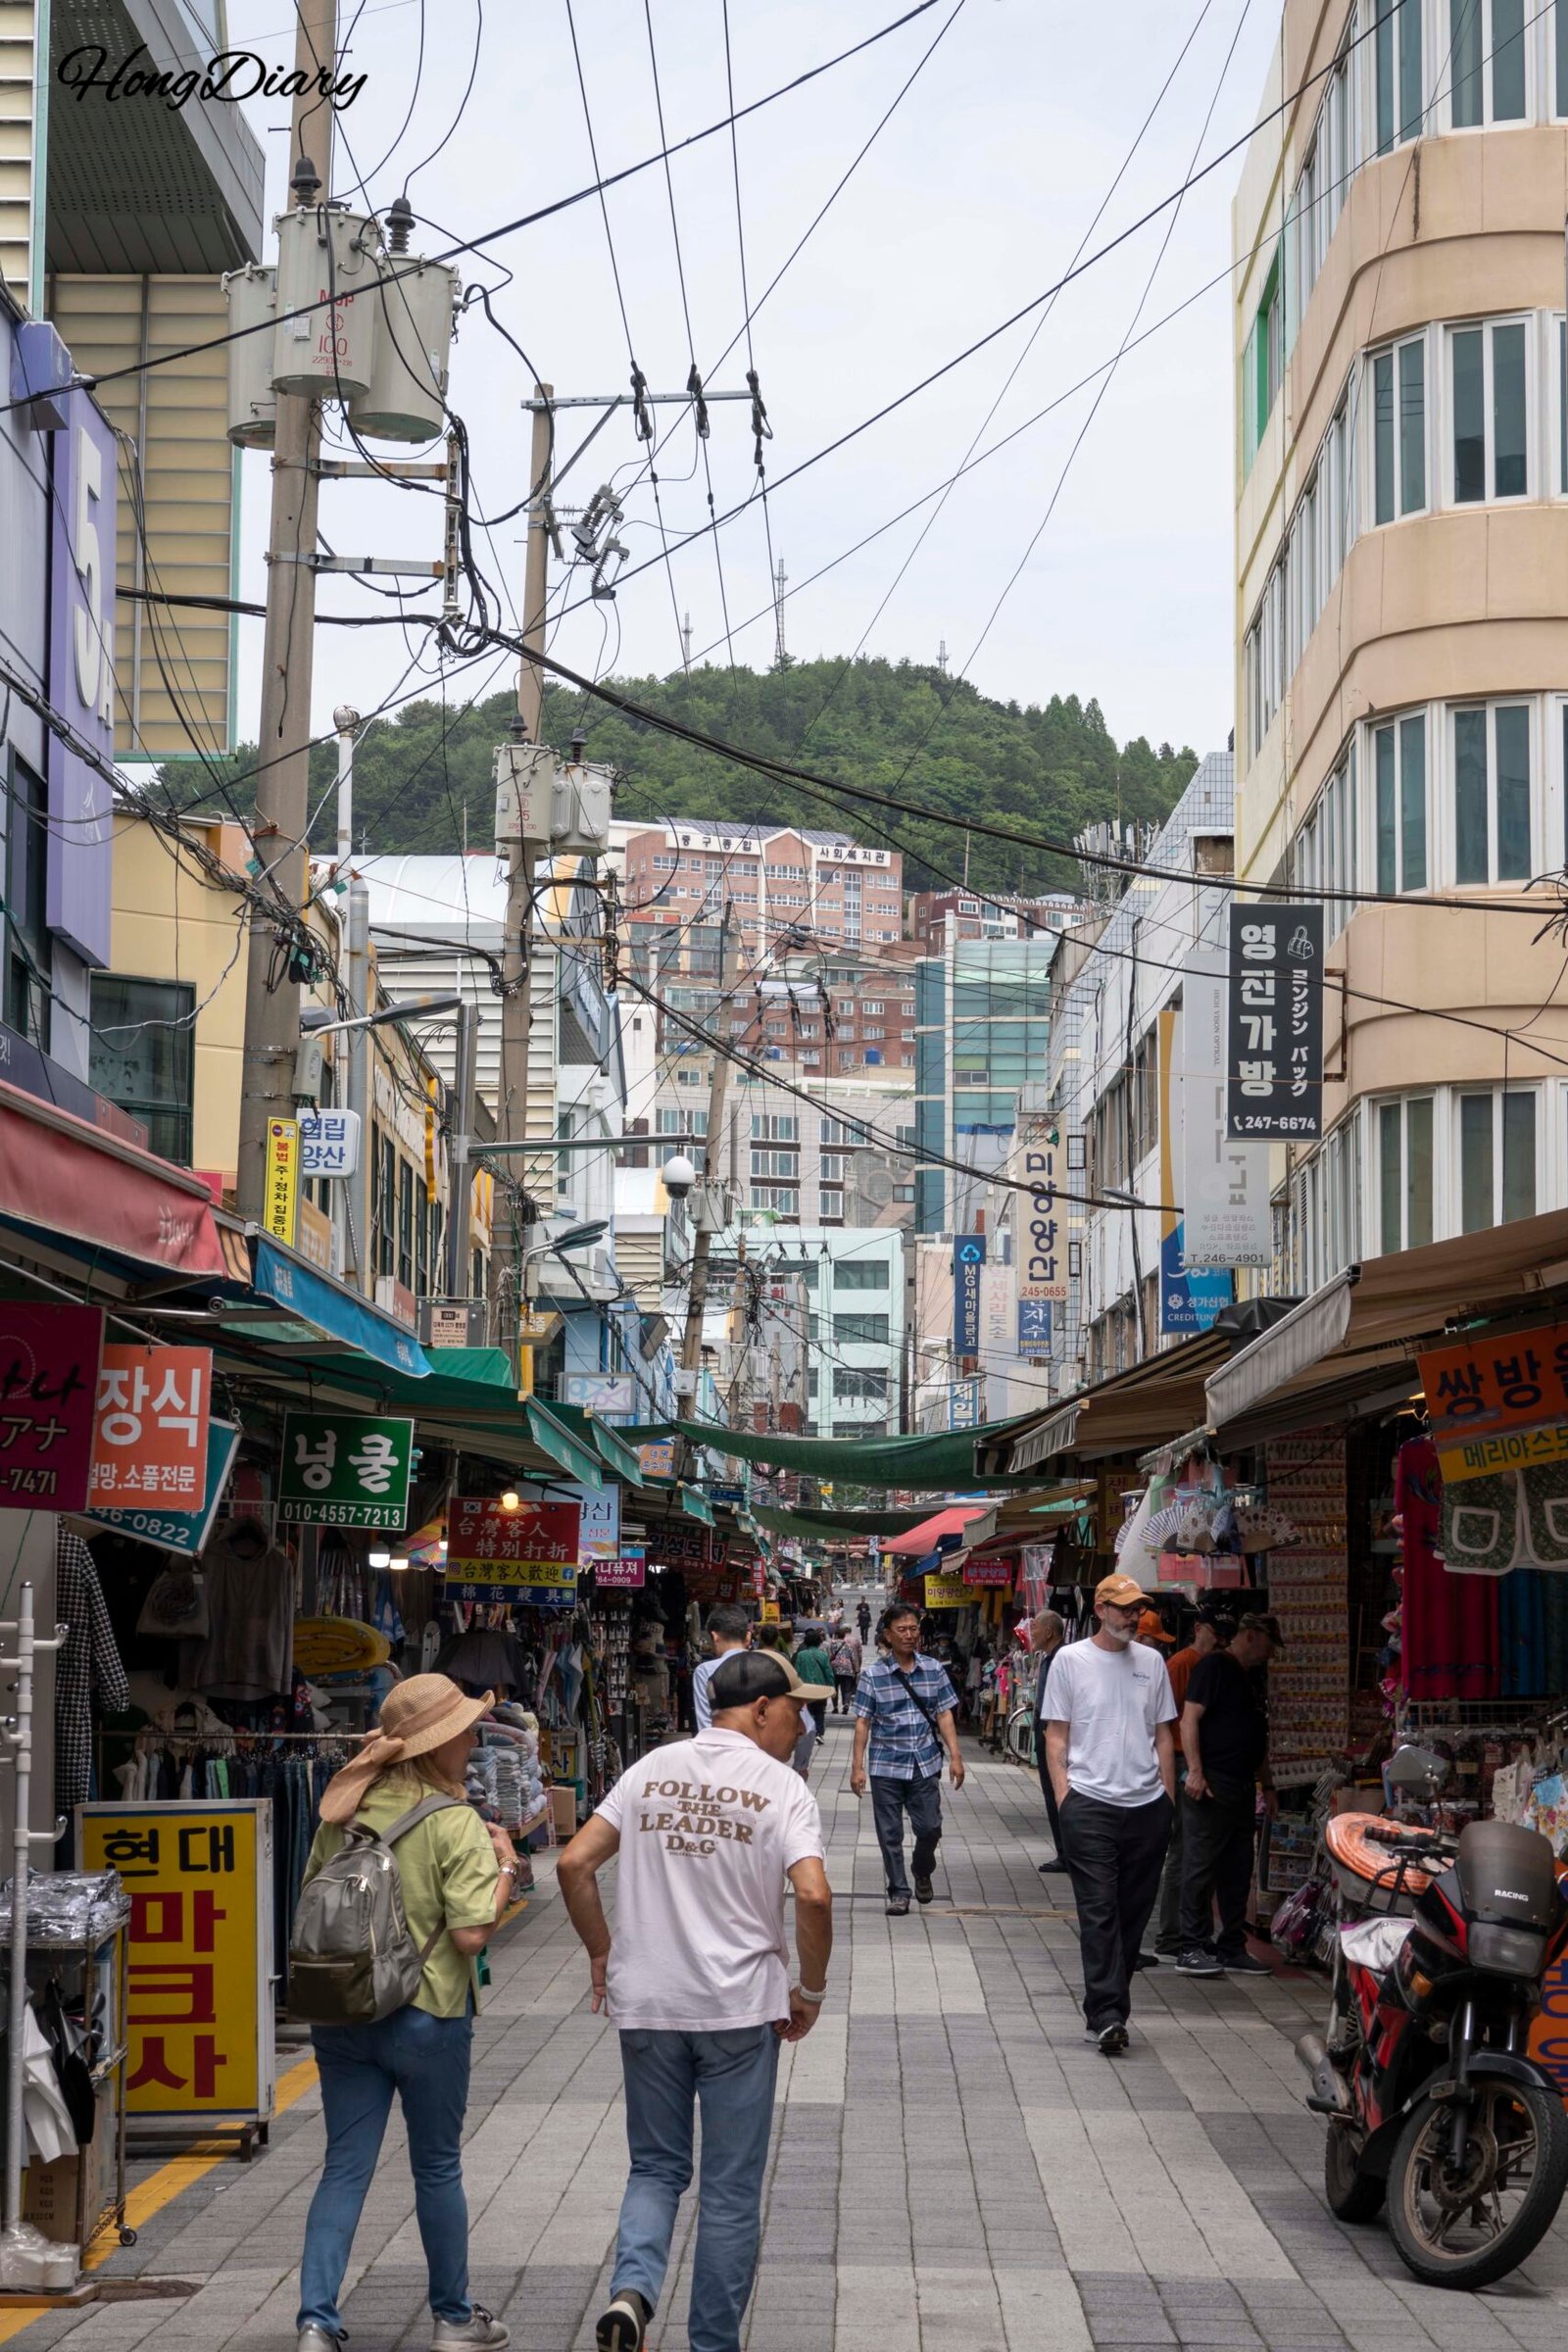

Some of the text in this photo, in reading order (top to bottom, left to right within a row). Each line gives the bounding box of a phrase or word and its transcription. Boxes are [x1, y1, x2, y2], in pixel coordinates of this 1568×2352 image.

[682, 834, 886, 863] 중구종합 사회복지관
[1239, 924, 1277, 1097] 영진가방
[301, 1117, 346, 1141] 협립
[1245, 1115, 1317, 1131] 247-6674
[275, 1142, 290, 1162] 불법
[303, 1146, 346, 1169] 양산
[271, 1204, 287, 1243] 집중단
[1026, 1152, 1058, 1281] 미양양산
[1190, 1253, 1264, 1263] T.246-4901
[1022, 1287, 1067, 1298] 245-0655
[1167, 1313, 1216, 1322] CREDITUN
[294, 1429, 400, 1494] 넝쿨
[87, 1506, 191, 1545] 46-0822
[284, 1501, 401, 1528] 010-4557-7213
[458, 1516, 551, 1539] 台灣客人
[474, 1539, 570, 1561] 特別打折
[464, 1561, 561, 1583] 台灣客人歡迎
[641, 1779, 771, 1813] FOLLOW
[676, 1799, 722, 1817] THE
[639, 1812, 754, 1844] LEADER
[102, 1824, 236, 1877] 현대
[664, 1834, 716, 1855] D&G
[1494, 1887, 1530, 1903] RACING
[126, 1889, 227, 2099] 마크사
